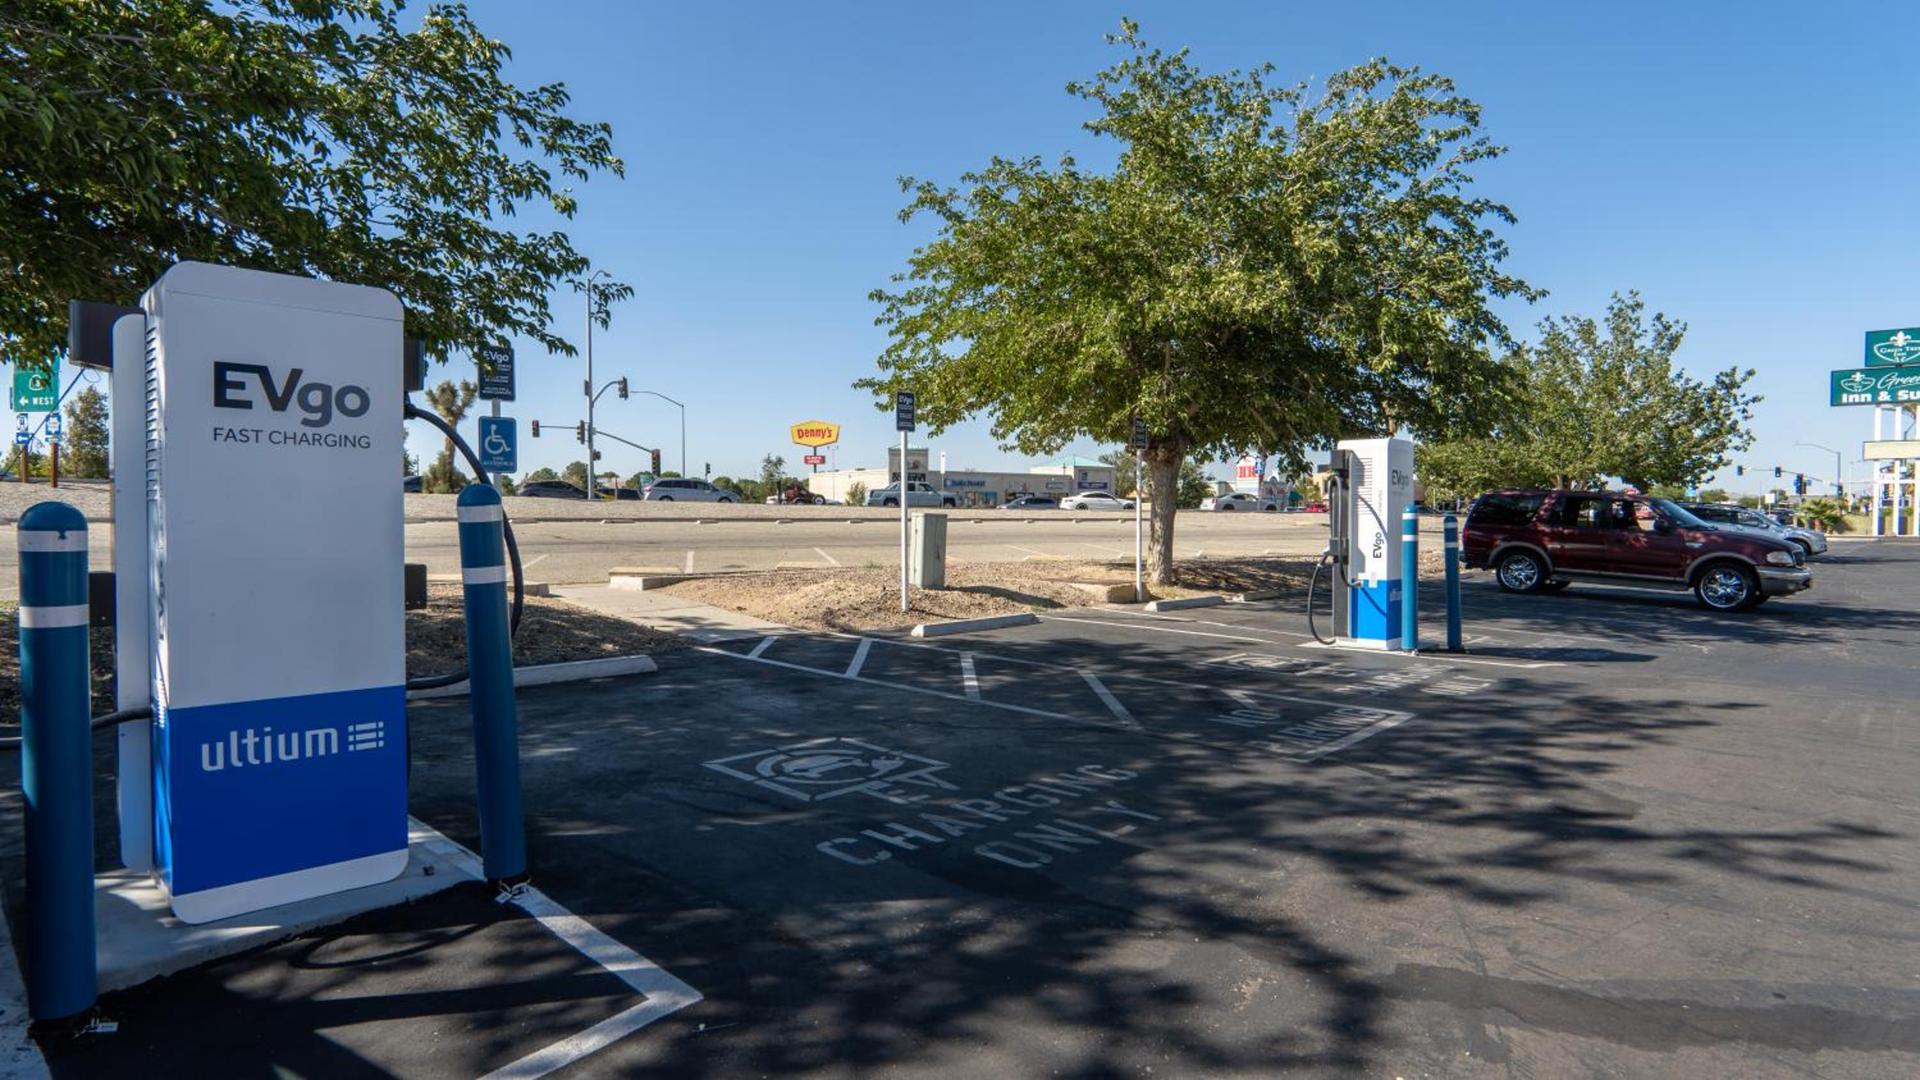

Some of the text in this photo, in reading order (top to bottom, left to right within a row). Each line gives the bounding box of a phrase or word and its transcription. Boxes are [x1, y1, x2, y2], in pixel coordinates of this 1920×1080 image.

[483, 351, 509, 363] EVgo
[1877, 372, 1920, 390] Gree
[32, 396, 54, 406] WEST
[214, 361, 370, 428] EVgo
[1842, 393, 1872, 403] Inn
[1878, 391, 1892, 401] &
[213, 427, 371, 449] FAST CHARGING
[797, 427, 833, 439] Denny's
[1372, 531, 1384, 558] EVgo
[202, 726, 338, 771] ultium
[815, 764, 1138, 866] CHARGING
[974, 800, 1161, 869] ONLY
